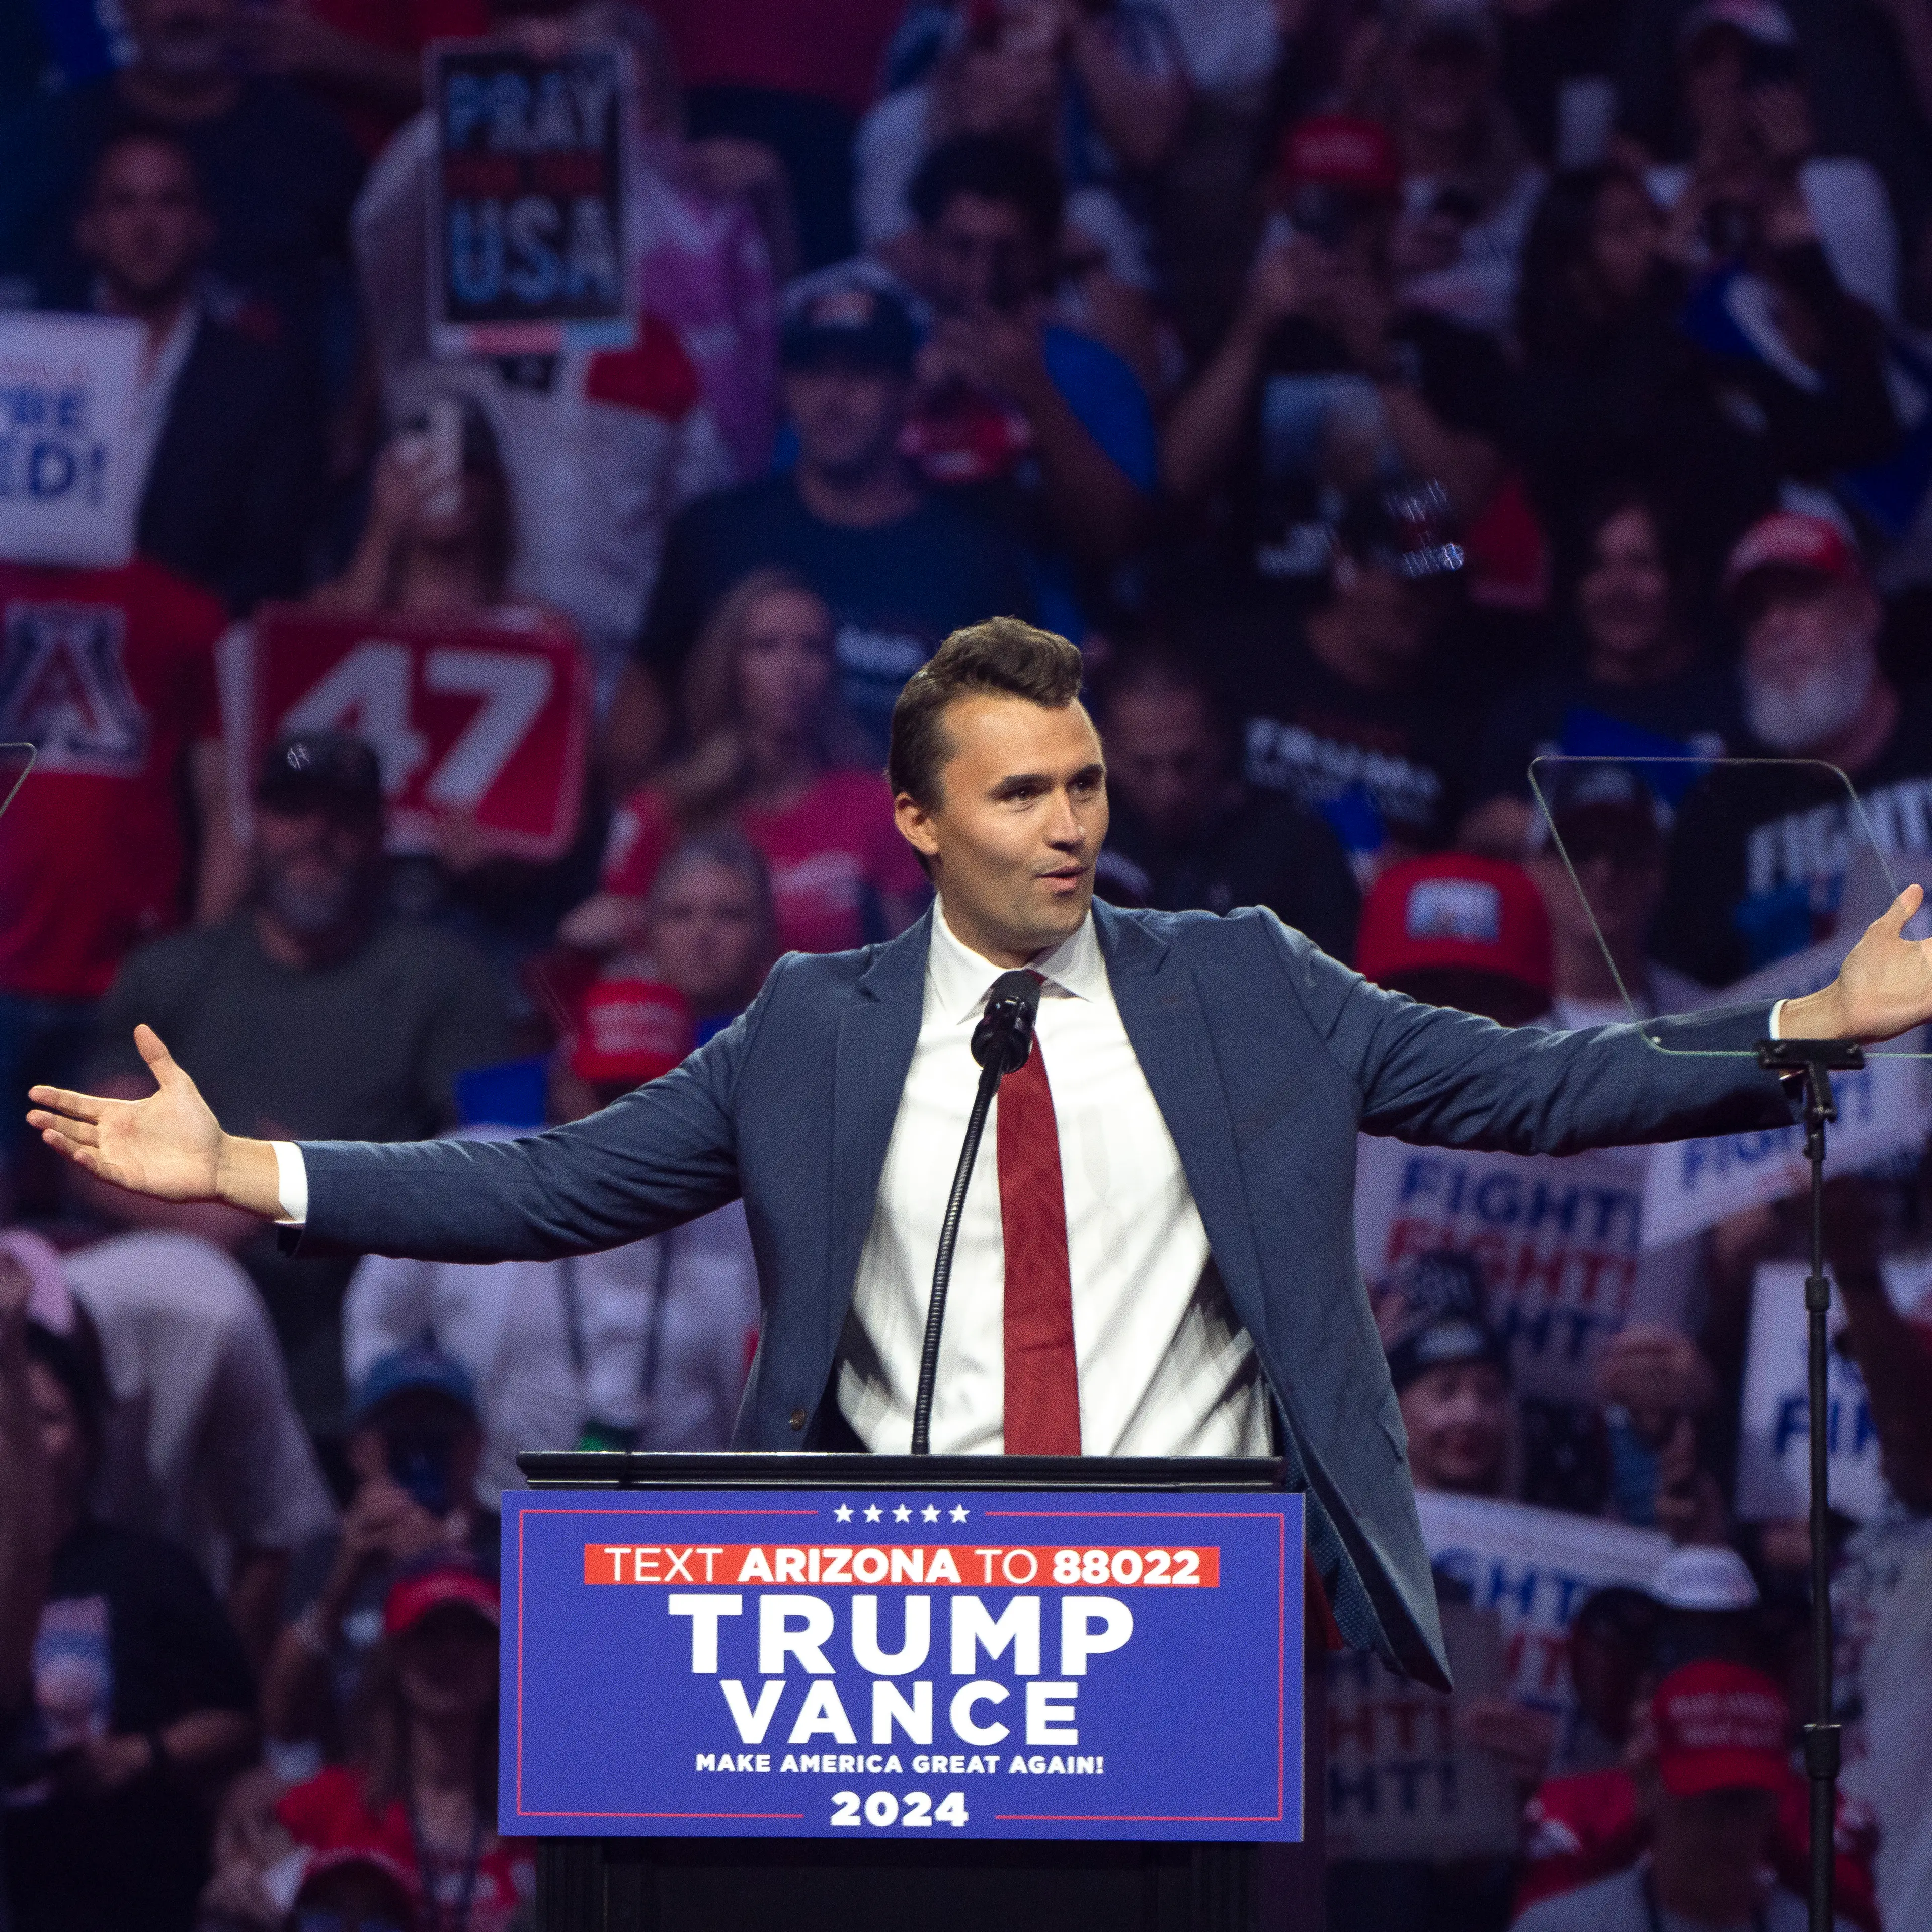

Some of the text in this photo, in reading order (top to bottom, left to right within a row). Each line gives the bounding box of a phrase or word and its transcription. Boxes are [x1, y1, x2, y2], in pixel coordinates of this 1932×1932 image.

[447, 69, 615, 152] PRAY
[449, 198, 616, 305] USA
[277, 638, 556, 806] 47
[1400, 1156, 1643, 1252] FIGHT!
[604, 1547, 1199, 1584] TEXT ARIZONA TO 88022
[668, 1593, 1134, 1676] TRUMP
[719, 1679, 1079, 1746] VANCE
[696, 1754, 1103, 1774] MAKE AMERICA GREAT AGAIN!
[830, 1791, 969, 1827] 2024
